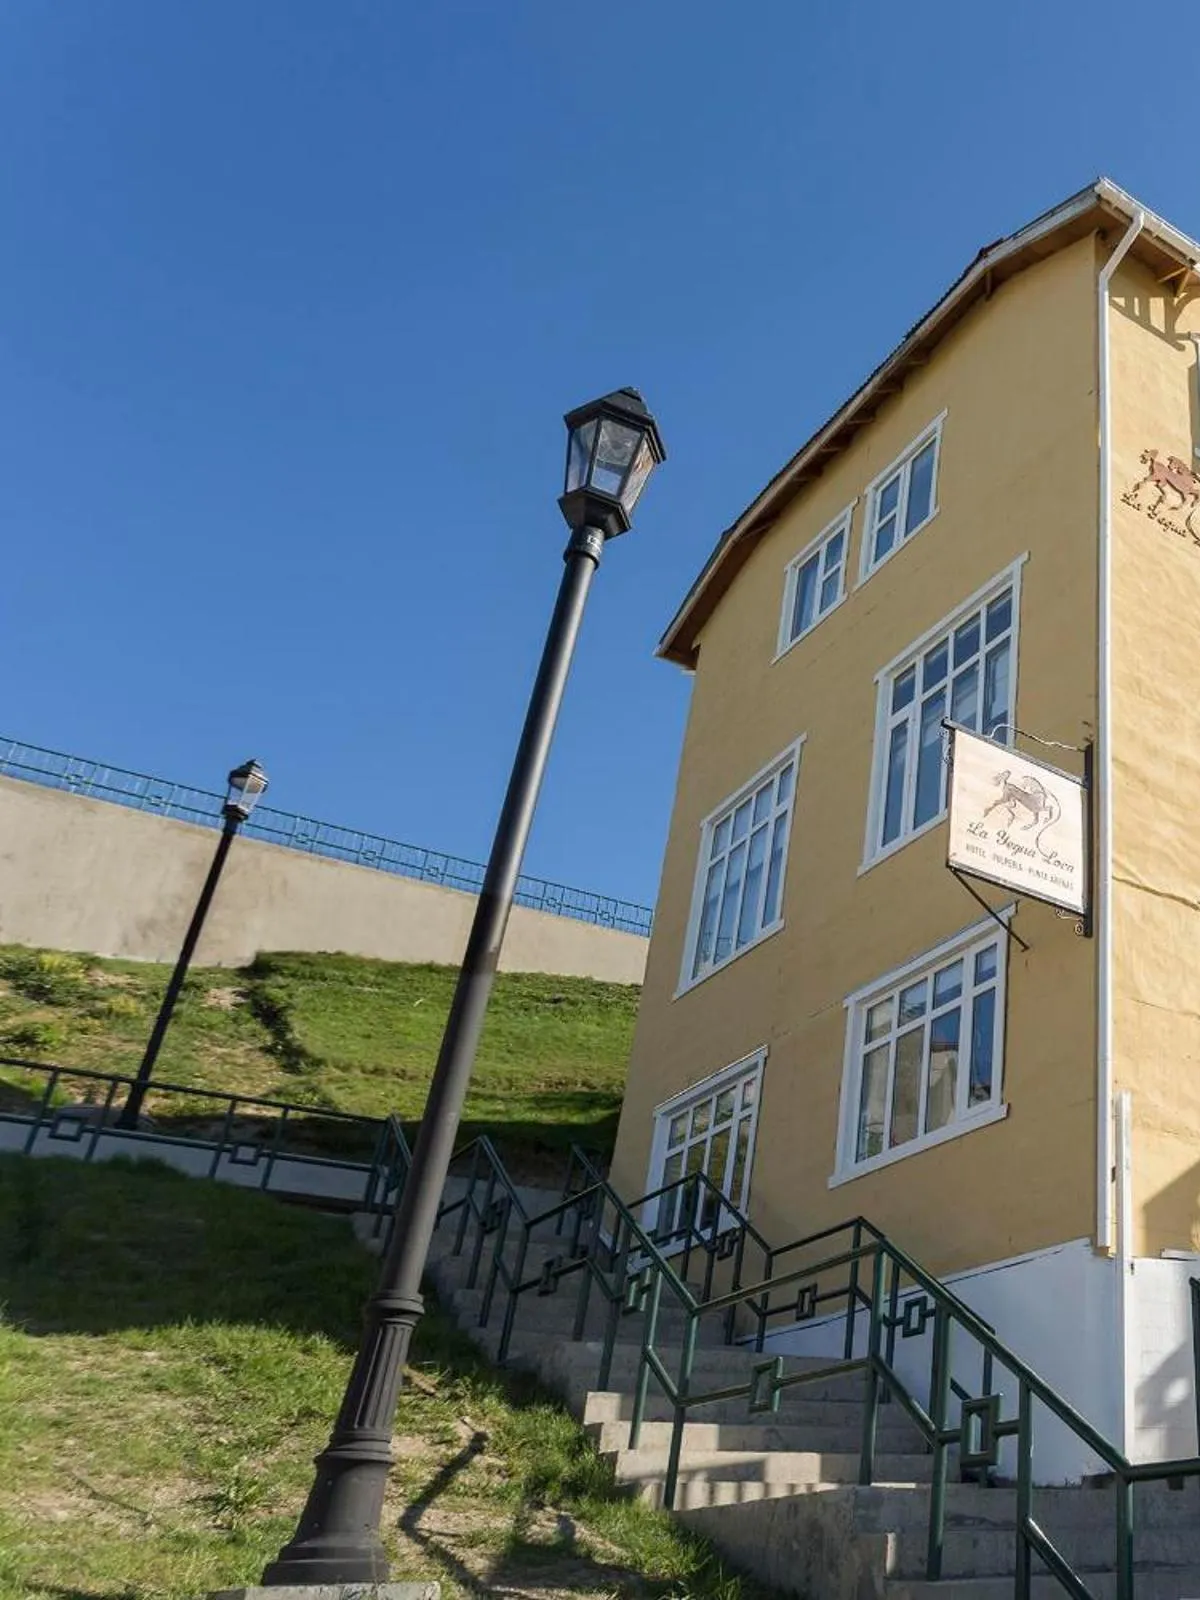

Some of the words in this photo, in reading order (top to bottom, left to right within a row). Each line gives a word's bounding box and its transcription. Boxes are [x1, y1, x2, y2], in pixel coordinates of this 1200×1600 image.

[1120, 492, 1141, 512] La
[967, 822, 988, 839] La
[996, 829, 1037, 858] Yegua
[1042, 850, 1075, 874] Loca
